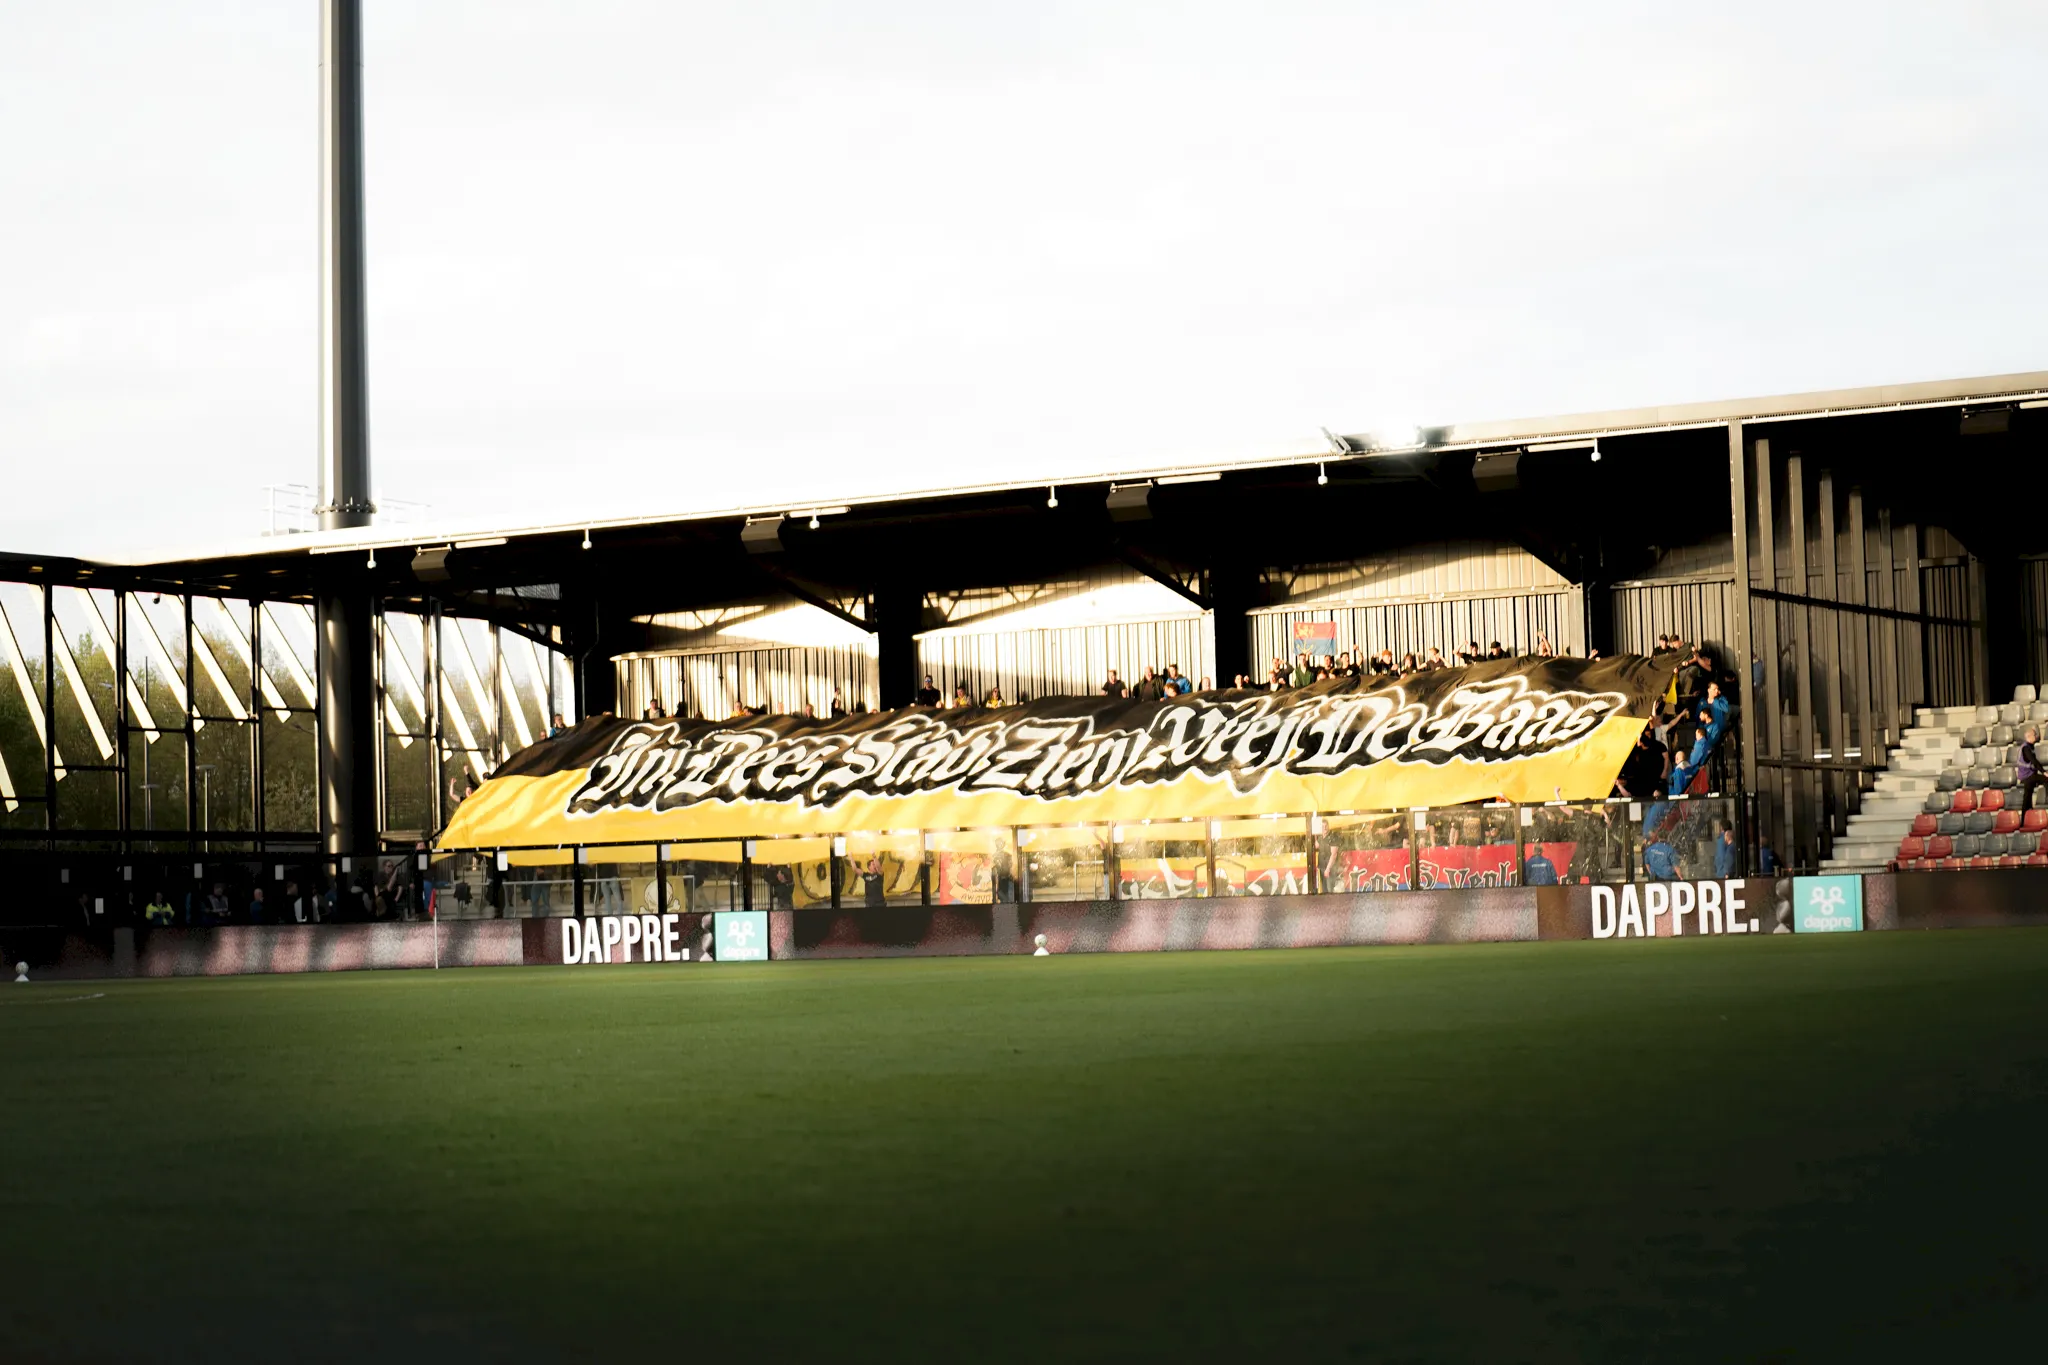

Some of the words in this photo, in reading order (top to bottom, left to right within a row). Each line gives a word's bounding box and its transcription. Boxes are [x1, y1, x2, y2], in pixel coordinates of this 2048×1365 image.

[569, 726, 678, 806] In
[661, 730, 840, 800] Dees
[1296, 695, 1424, 769] De
[1410, 685, 1614, 754] Baas
[1591, 879, 1760, 939] DAPPRE.
[1803, 915, 1853, 932] dappre
[562, 913, 690, 965] DAPPRE.
